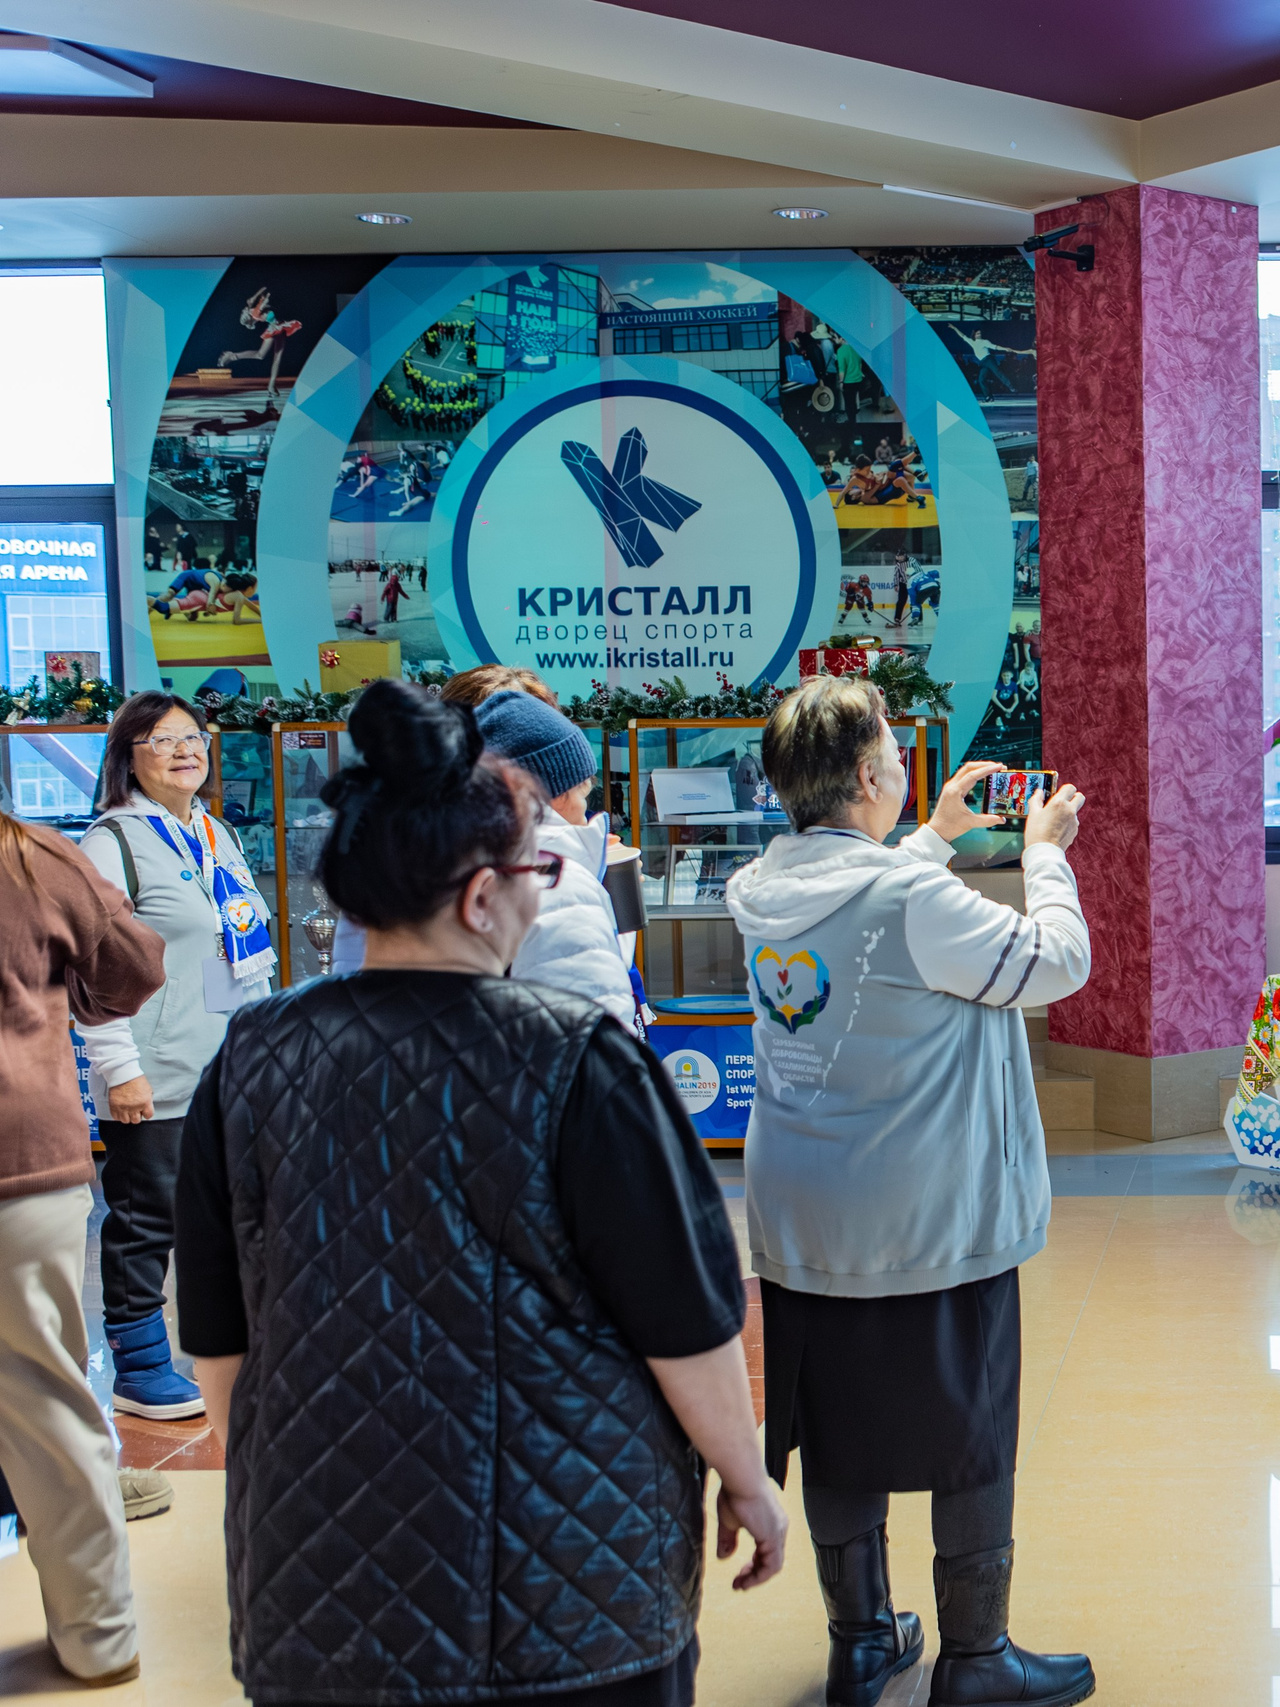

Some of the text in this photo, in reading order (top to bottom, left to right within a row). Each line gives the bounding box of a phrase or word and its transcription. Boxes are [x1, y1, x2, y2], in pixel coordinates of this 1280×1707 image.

[606, 305, 758, 326] НАСТОЯЩИЙ ХОККЕЙ
[0, 538, 97, 557] ОВОЧНАЯ
[20, 564, 88, 581] АРЕНА
[518, 585, 751, 617] КРИСТАЛЛ
[516, 622, 753, 645] дворец спорта
[535, 646, 734, 668] www.ikristall.ru
[725, 1055, 754, 1065] ПЕРВ
[771, 1048, 823, 1064] ДОБРОВОЛЬЦЫ
[725, 1069, 755, 1079] СПОР
[725, 1085, 739, 1094] 1st
[726, 1098, 753, 1109] Sport
